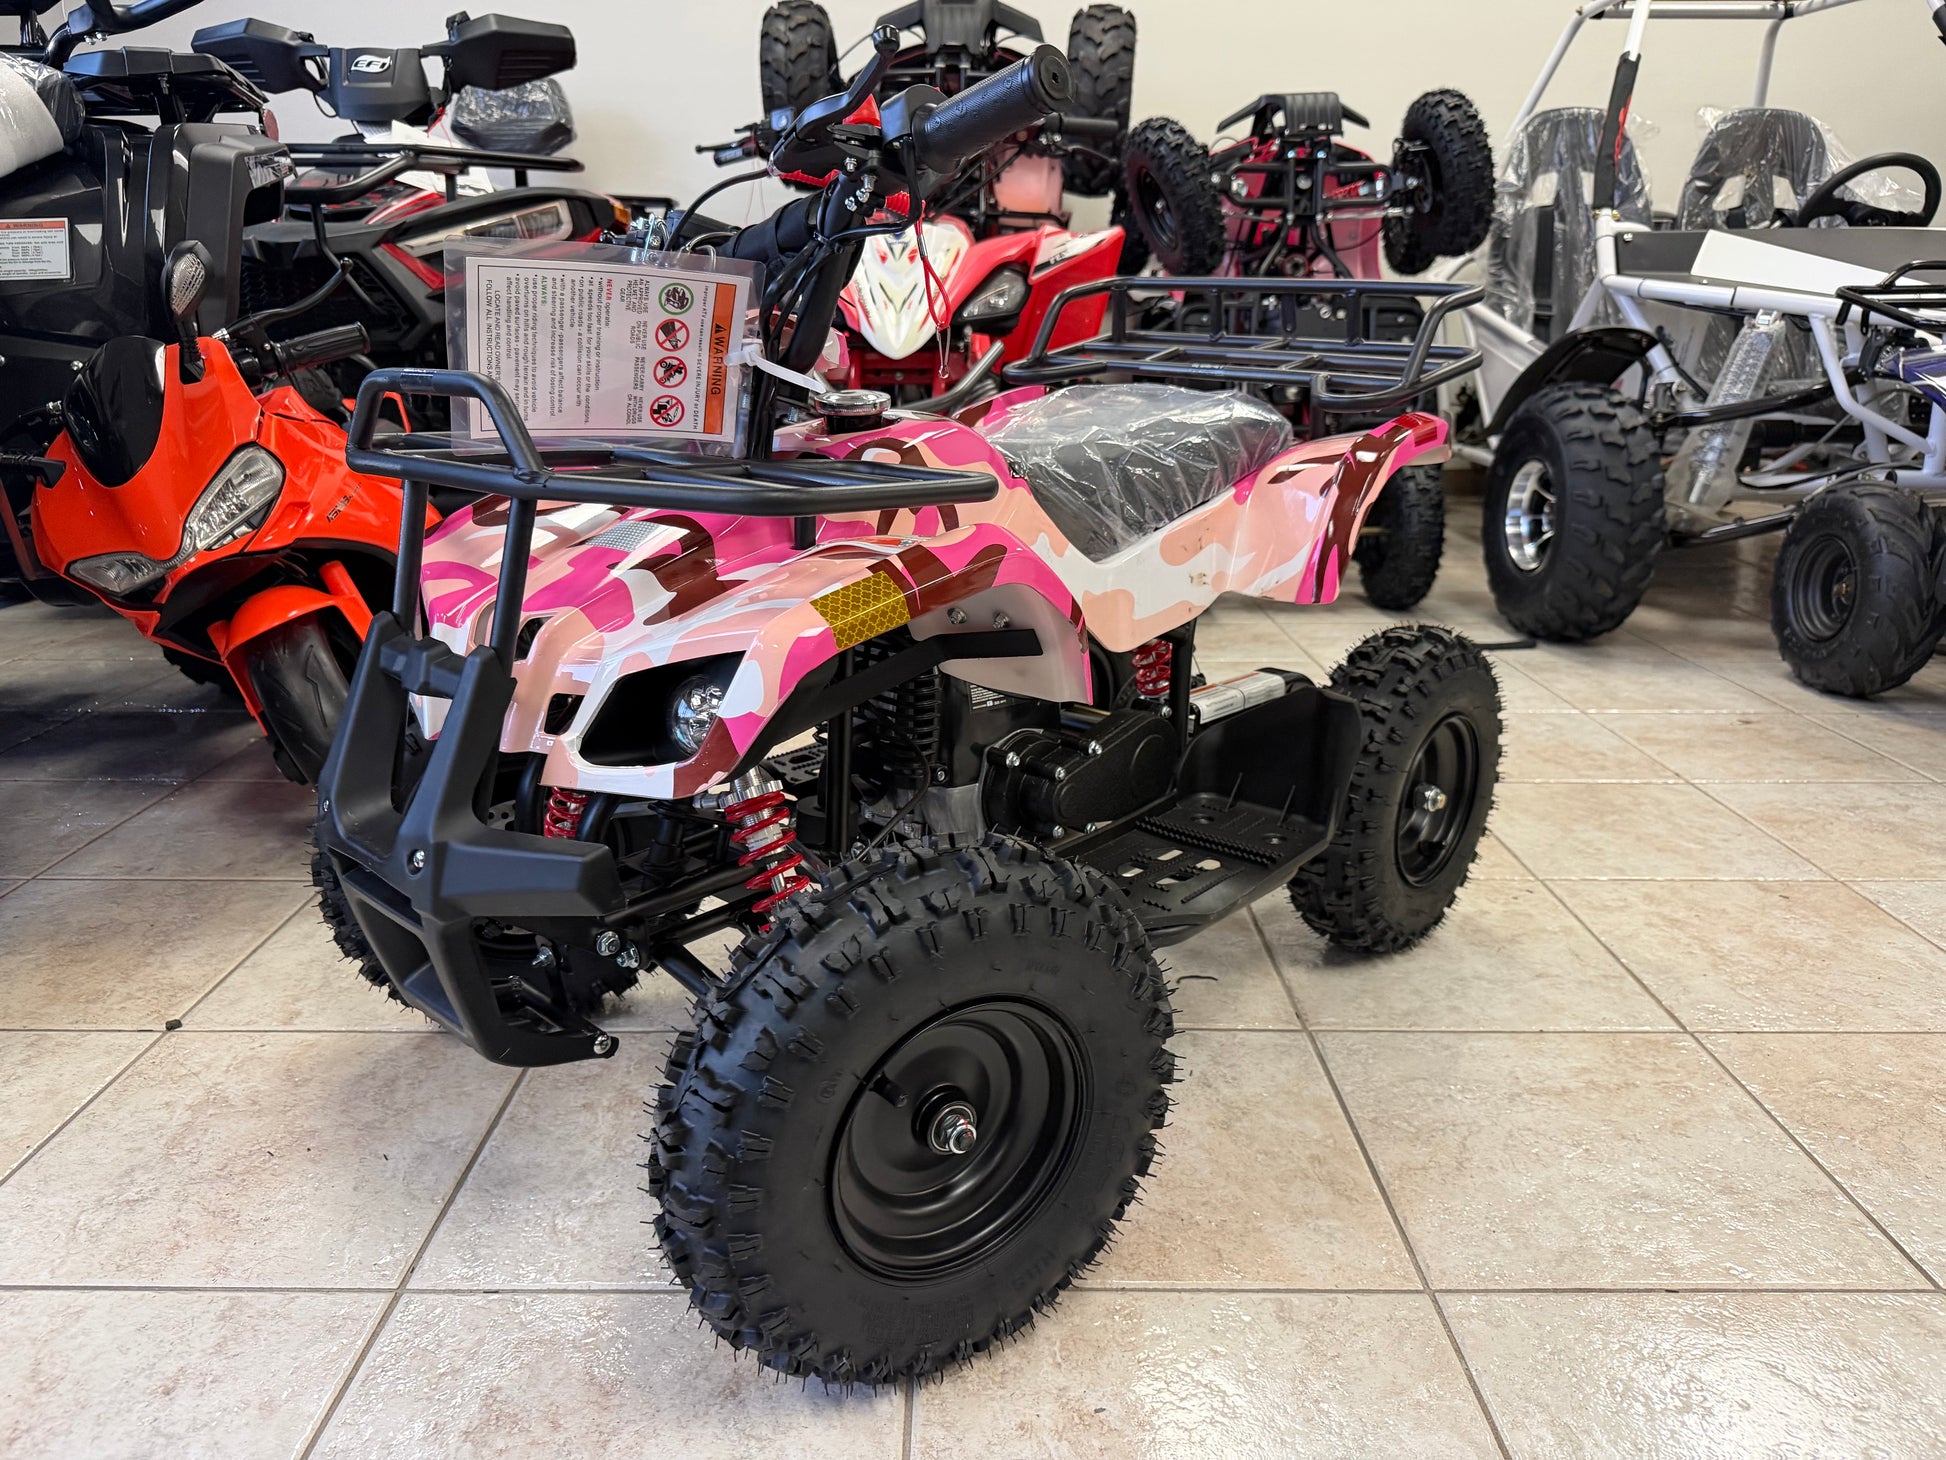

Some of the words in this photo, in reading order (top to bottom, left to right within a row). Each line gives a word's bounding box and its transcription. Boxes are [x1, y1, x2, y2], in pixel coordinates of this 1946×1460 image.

[354, 60, 387, 69] EFI
[578, 279, 583, 287] on
[710, 336, 725, 394] WARNING
